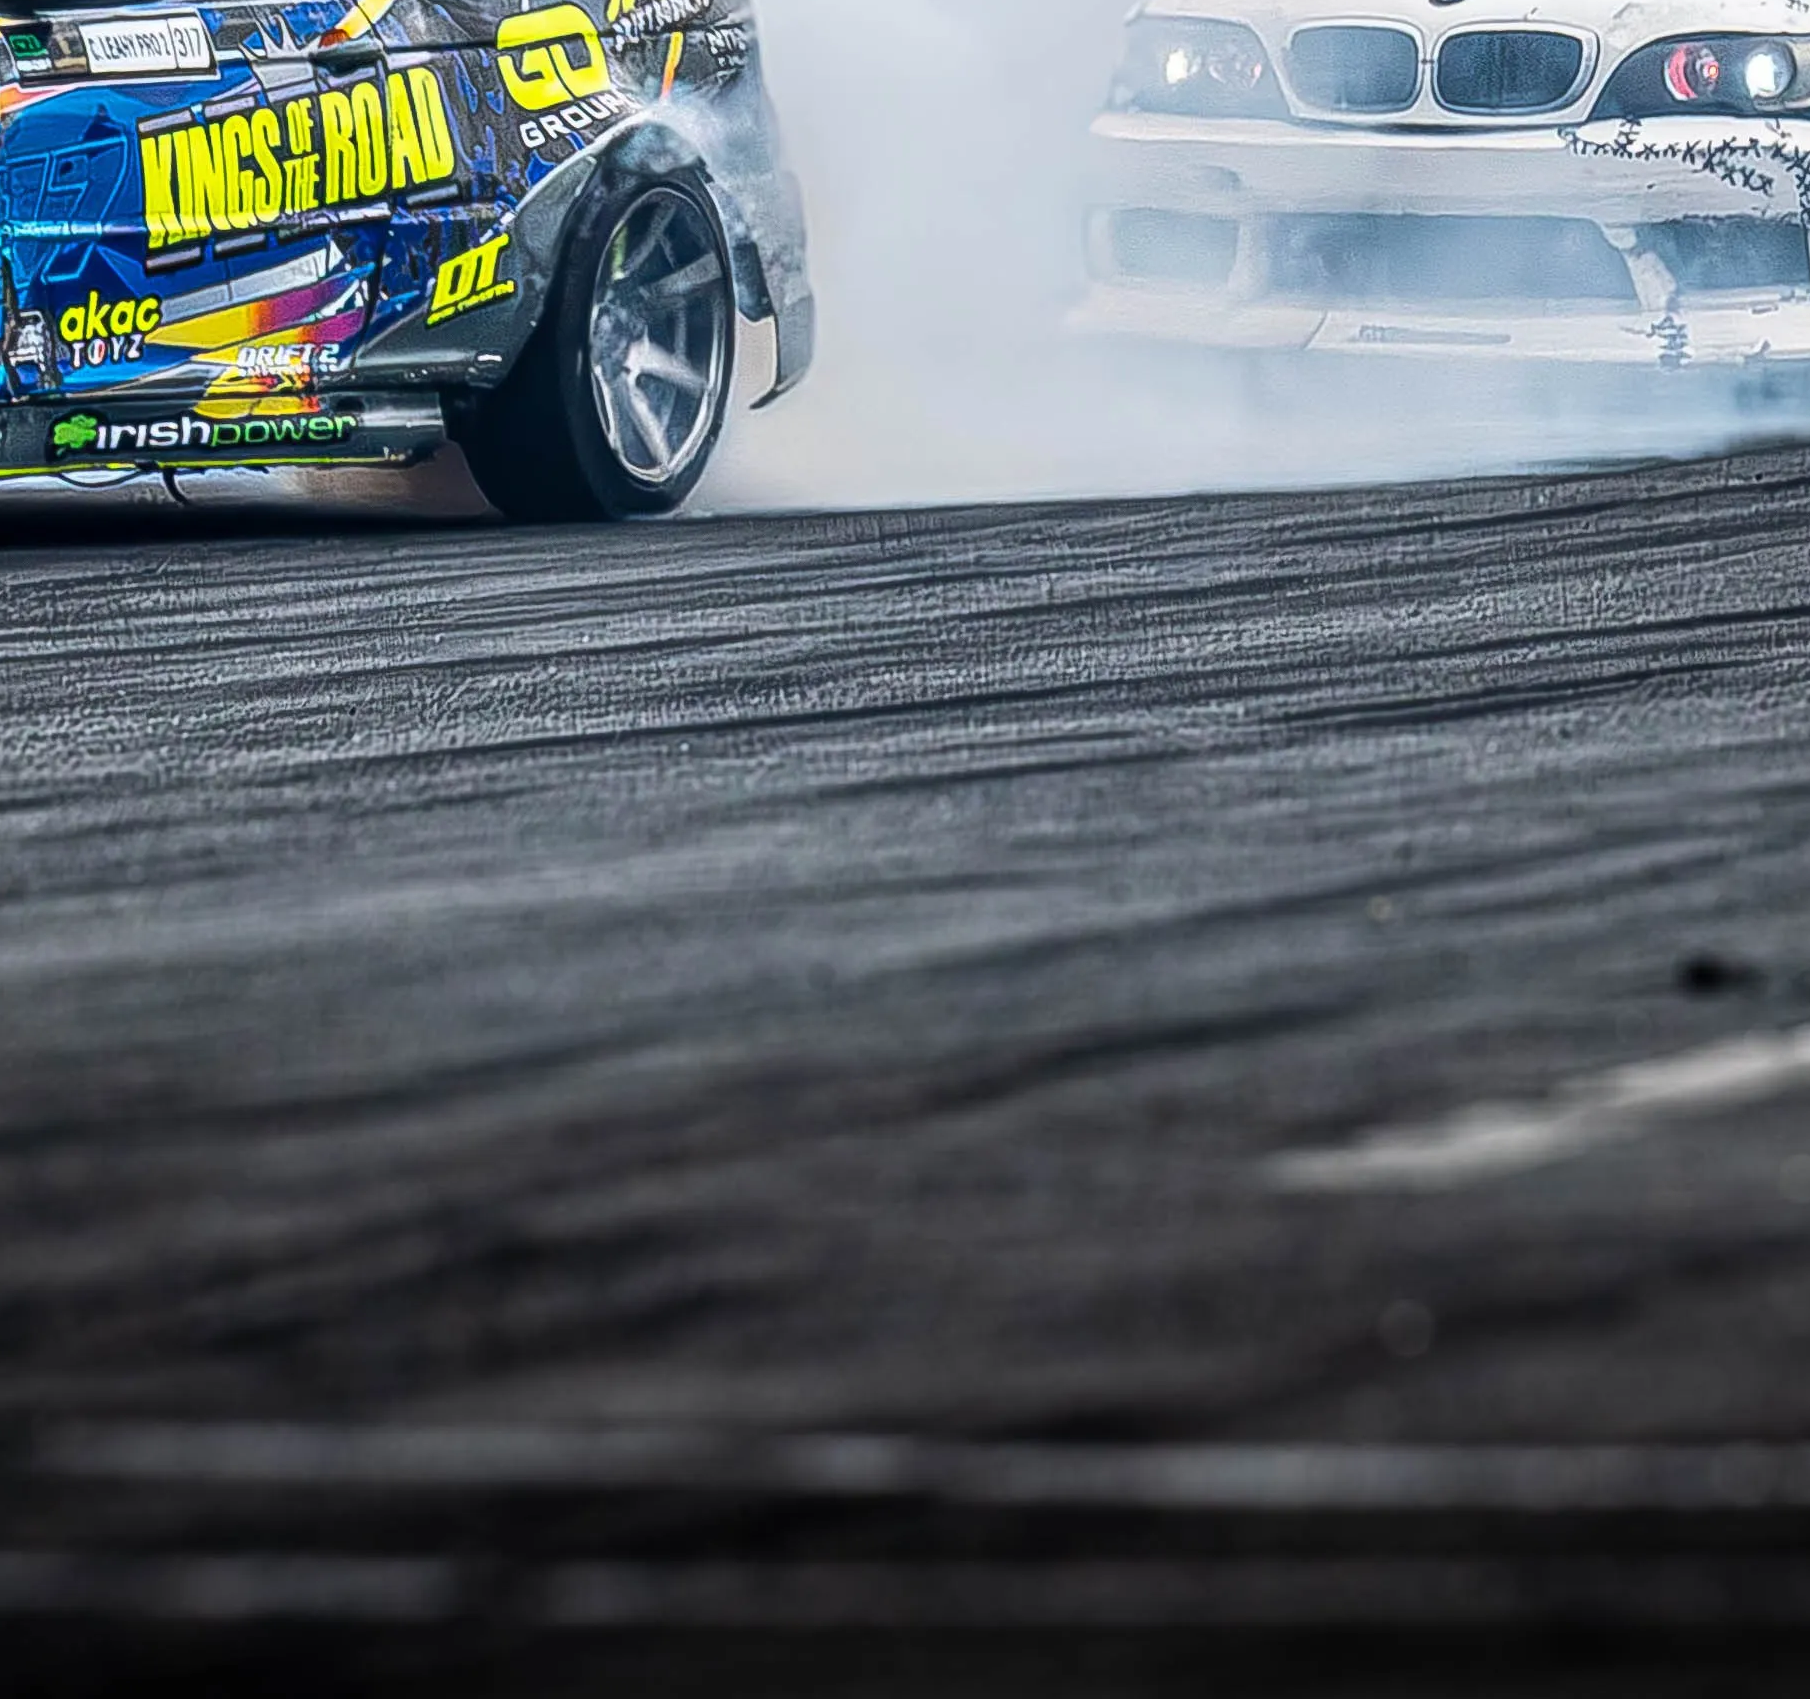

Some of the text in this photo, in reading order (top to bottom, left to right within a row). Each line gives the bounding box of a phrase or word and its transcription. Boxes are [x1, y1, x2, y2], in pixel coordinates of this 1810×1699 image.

[173, 27, 202, 57] 317
[141, 67, 455, 249] KINGS OF THE ROAD
[59, 290, 160, 342] akac
[72, 333, 143, 368] TOYZ
